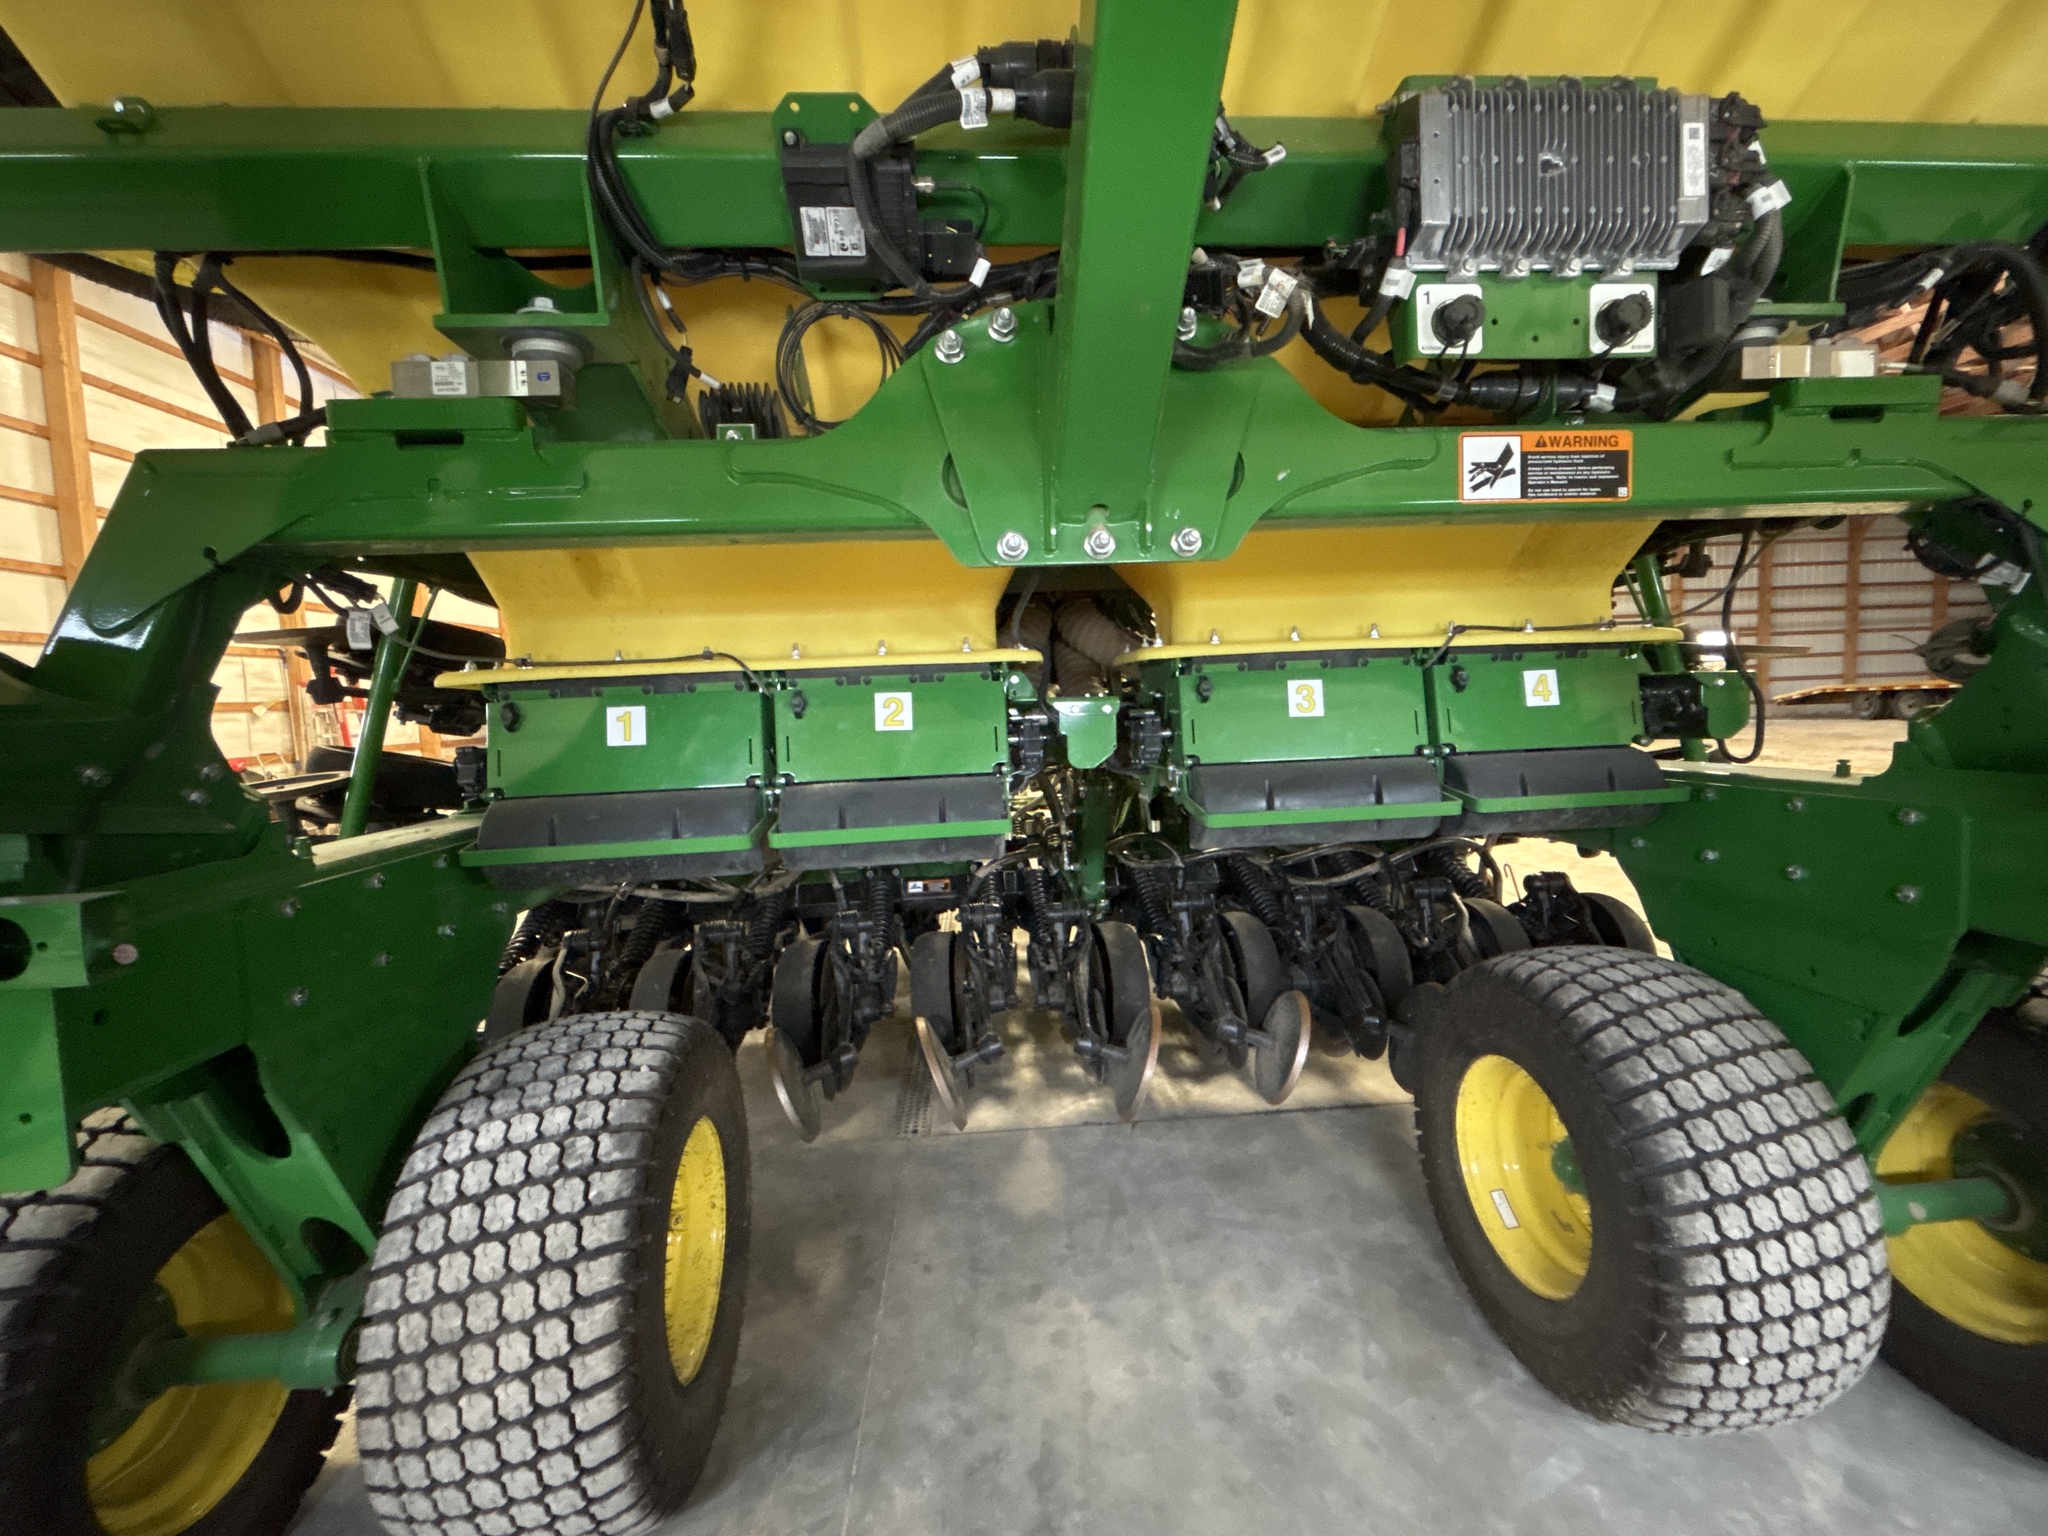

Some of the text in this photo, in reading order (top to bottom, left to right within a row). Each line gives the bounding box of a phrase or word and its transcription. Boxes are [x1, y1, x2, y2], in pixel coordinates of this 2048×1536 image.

[1423, 290, 1430, 305] 1
[1549, 435, 1618, 448] WARNING
[1296, 685, 1316, 712] 3
[1532, 675, 1551, 701] 4
[882, 698, 905, 726] 2
[615, 712, 631, 741] 1
